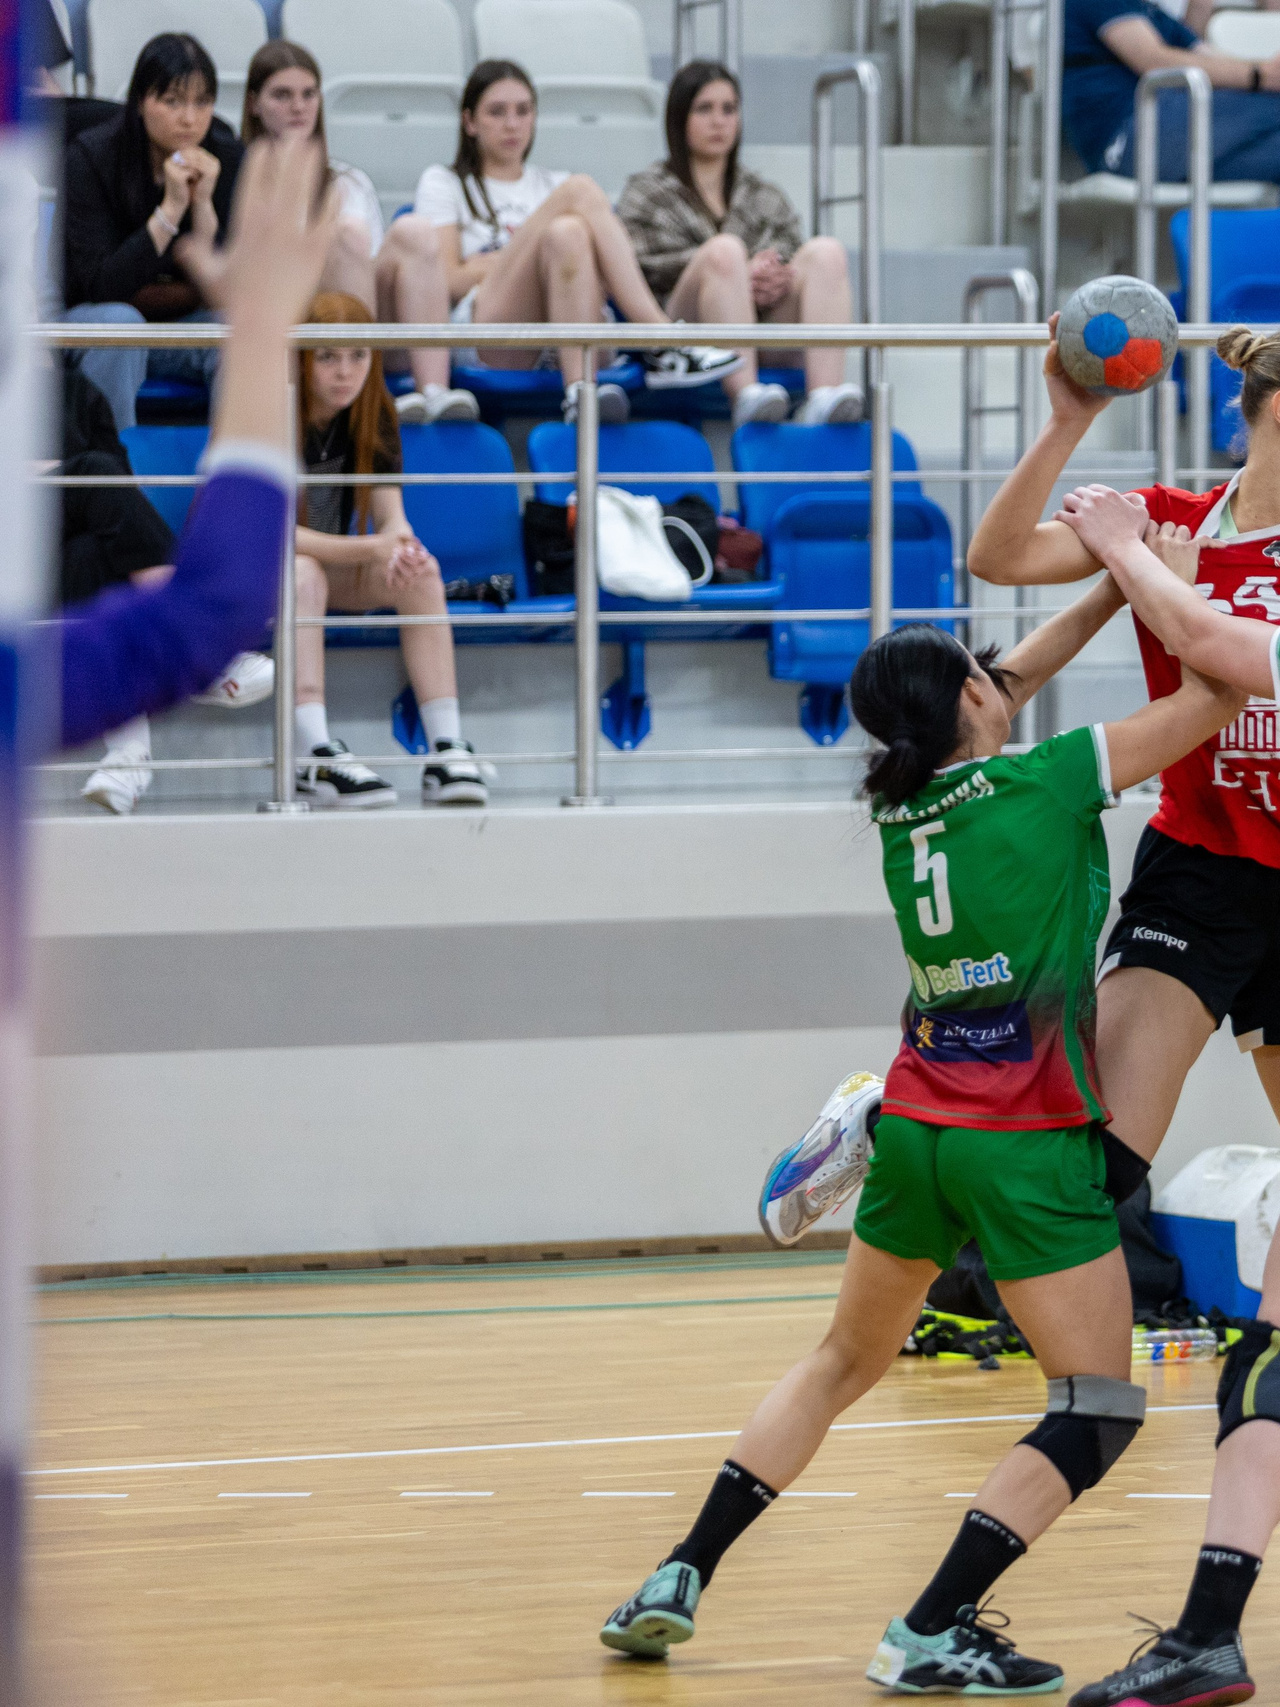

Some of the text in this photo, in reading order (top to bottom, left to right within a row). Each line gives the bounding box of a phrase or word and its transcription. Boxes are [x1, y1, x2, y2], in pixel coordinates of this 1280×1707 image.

[909, 820, 953, 937] 5
[1132, 926, 1188, 951] Kempa
[928, 953, 1010, 995] BelFert
